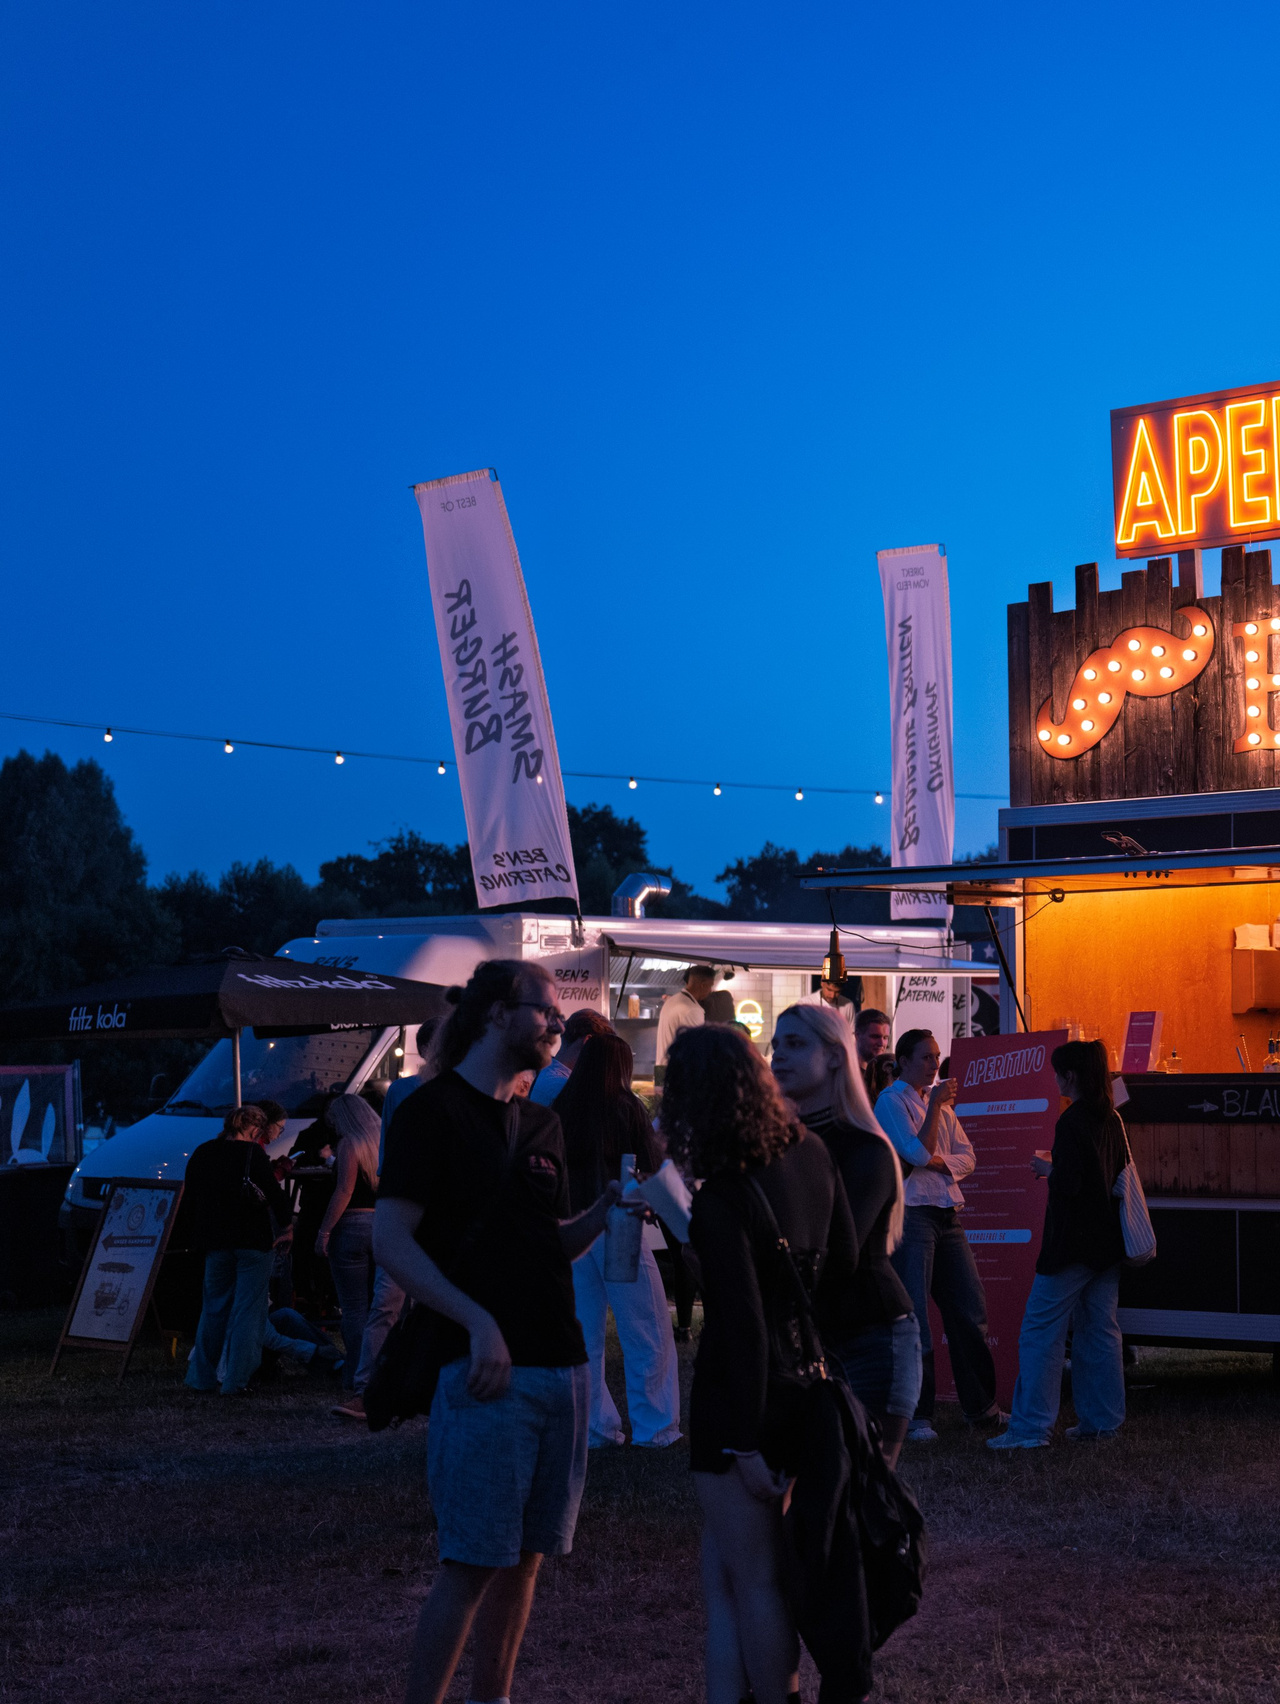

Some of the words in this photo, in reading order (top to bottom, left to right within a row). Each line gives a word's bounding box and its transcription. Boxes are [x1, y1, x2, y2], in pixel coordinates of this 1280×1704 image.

[557, 986, 600, 1001] TERING
[898, 987, 945, 1003] CATERING
[963, 1045, 1046, 1088] APERITIVO
